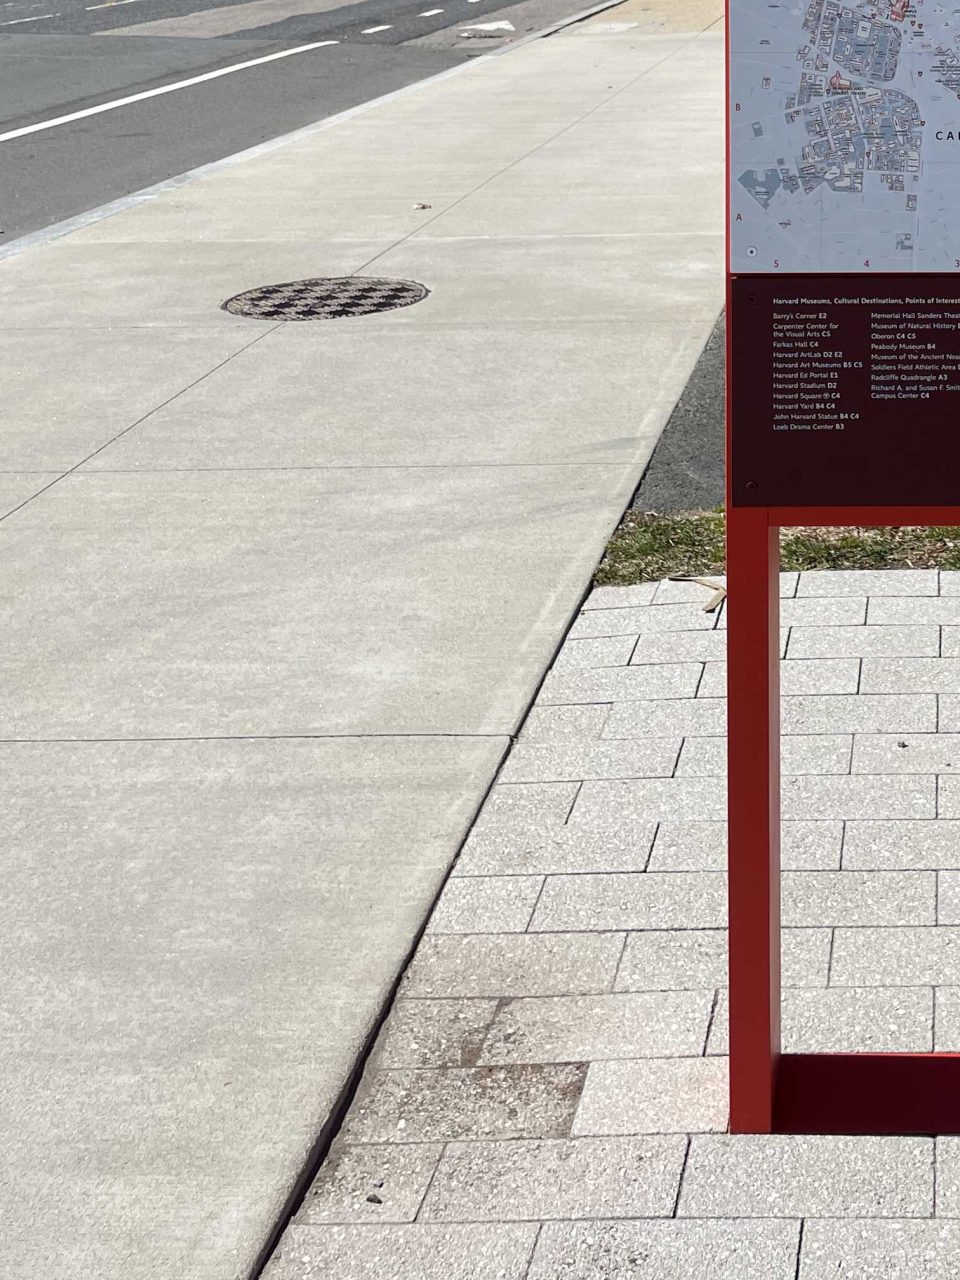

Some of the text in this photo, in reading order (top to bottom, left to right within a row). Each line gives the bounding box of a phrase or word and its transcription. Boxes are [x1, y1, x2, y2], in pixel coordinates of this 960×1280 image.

[735, 103, 741, 112] B
[735, 213, 743, 221] A
[773, 259, 779, 268] 5
[864, 259, 870, 268] 4
[955, 259, 960, 268] 3
[772, 297, 799, 305] Harvard
[800, 297, 833, 305] Museums,
[860, 297, 904, 305] Destinations,
[772, 312, 794, 321] Barry's
[795, 312, 818, 320] Corner
[772, 323, 805, 331] Carpenter
[806, 322, 828, 330] Center
[870, 322, 898, 330] Museum
[932, 322, 957, 331] History
[772, 330, 785, 338] the
[786, 330, 805, 338] Visual
[806, 330, 821, 338] Arts
[870, 332, 895, 340] Oberon
[870, 343, 898, 352] Peabody
[772, 361, 799, 369] Harvard
[811, 361, 842, 369] Museums
